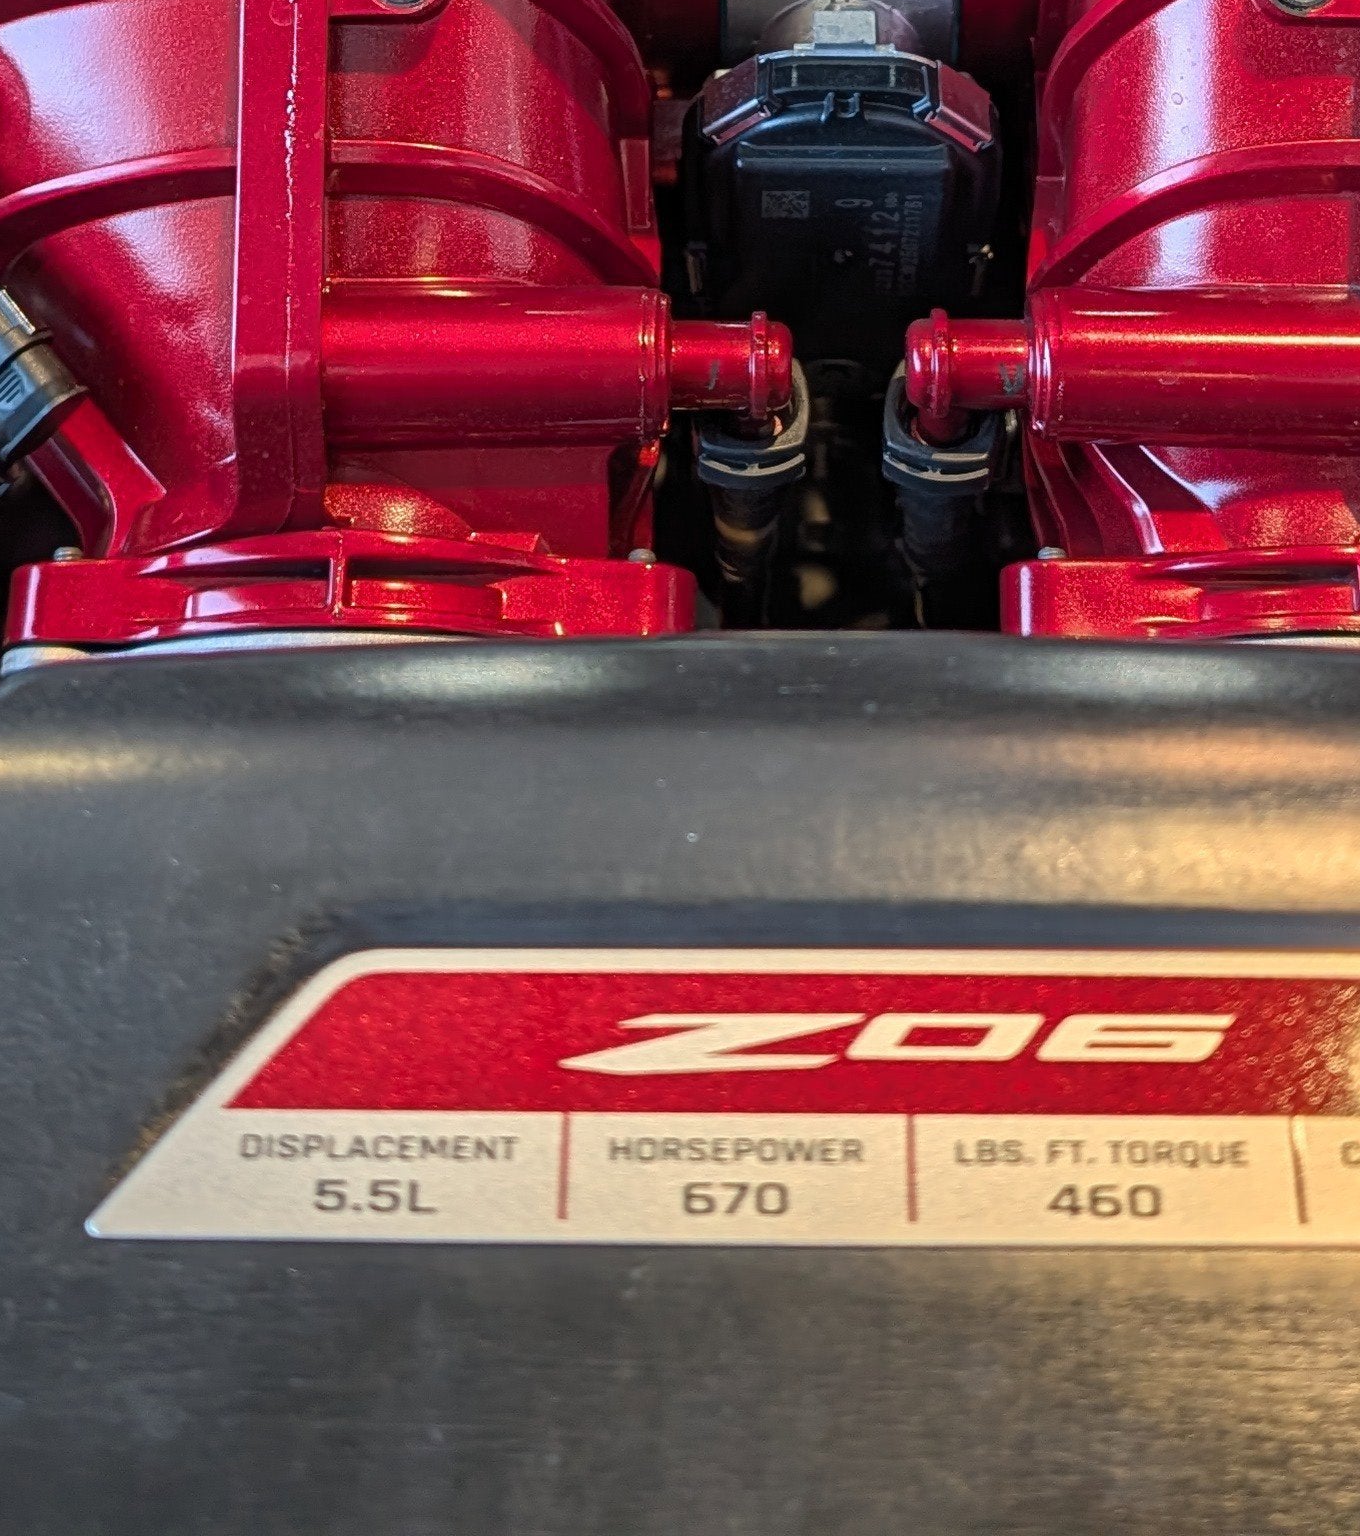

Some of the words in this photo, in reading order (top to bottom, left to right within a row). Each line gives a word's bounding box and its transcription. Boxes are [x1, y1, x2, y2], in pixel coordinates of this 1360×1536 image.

[558, 1013, 1238, 1076] Z06
[240, 1132, 520, 1162] DISPLACEMENT
[607, 1136, 866, 1164] HORSEPOWER
[953, 1139, 1035, 1166] LBS.
[1046, 1139, 1098, 1166] FT.
[1107, 1139, 1251, 1168] TORQUE
[313, 1179, 438, 1215] 5.5L
[681, 1181, 790, 1217] 670
[1046, 1183, 1164, 1219] 460
